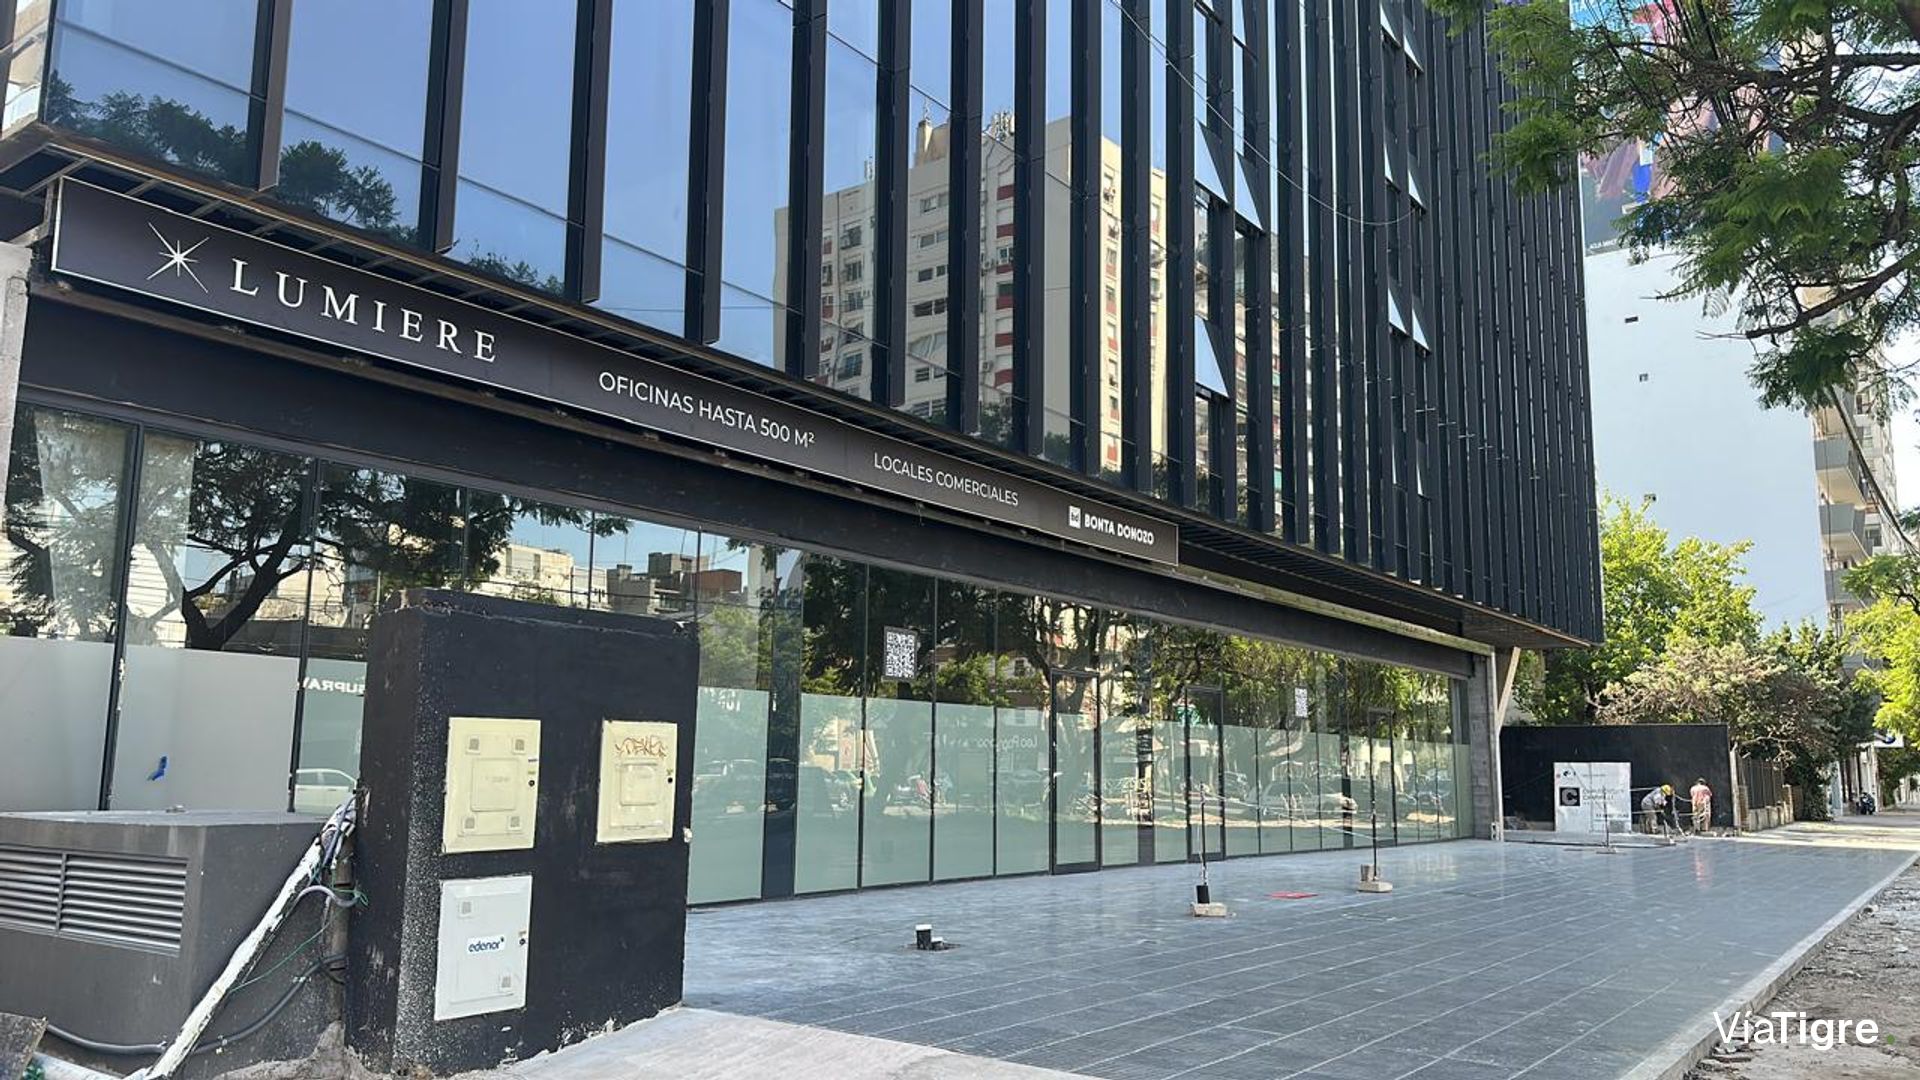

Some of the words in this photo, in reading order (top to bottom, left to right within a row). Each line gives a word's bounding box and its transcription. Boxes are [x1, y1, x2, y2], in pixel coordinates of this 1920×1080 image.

[230, 258, 496, 363] LUMIERE
[599, 371, 694, 414] OFICINAS
[699, 399, 757, 433] HASTA
[760, 418, 790, 442] 500
[795, 429, 815, 448] M²
[874, 452, 933, 483] LOCALES
[936, 471, 1018, 506] COMERCIALES
[1084, 513, 1115, 535] BONTA
[1117, 523, 1154, 545] DONOZO
[468, 939, 501, 953] edenor
